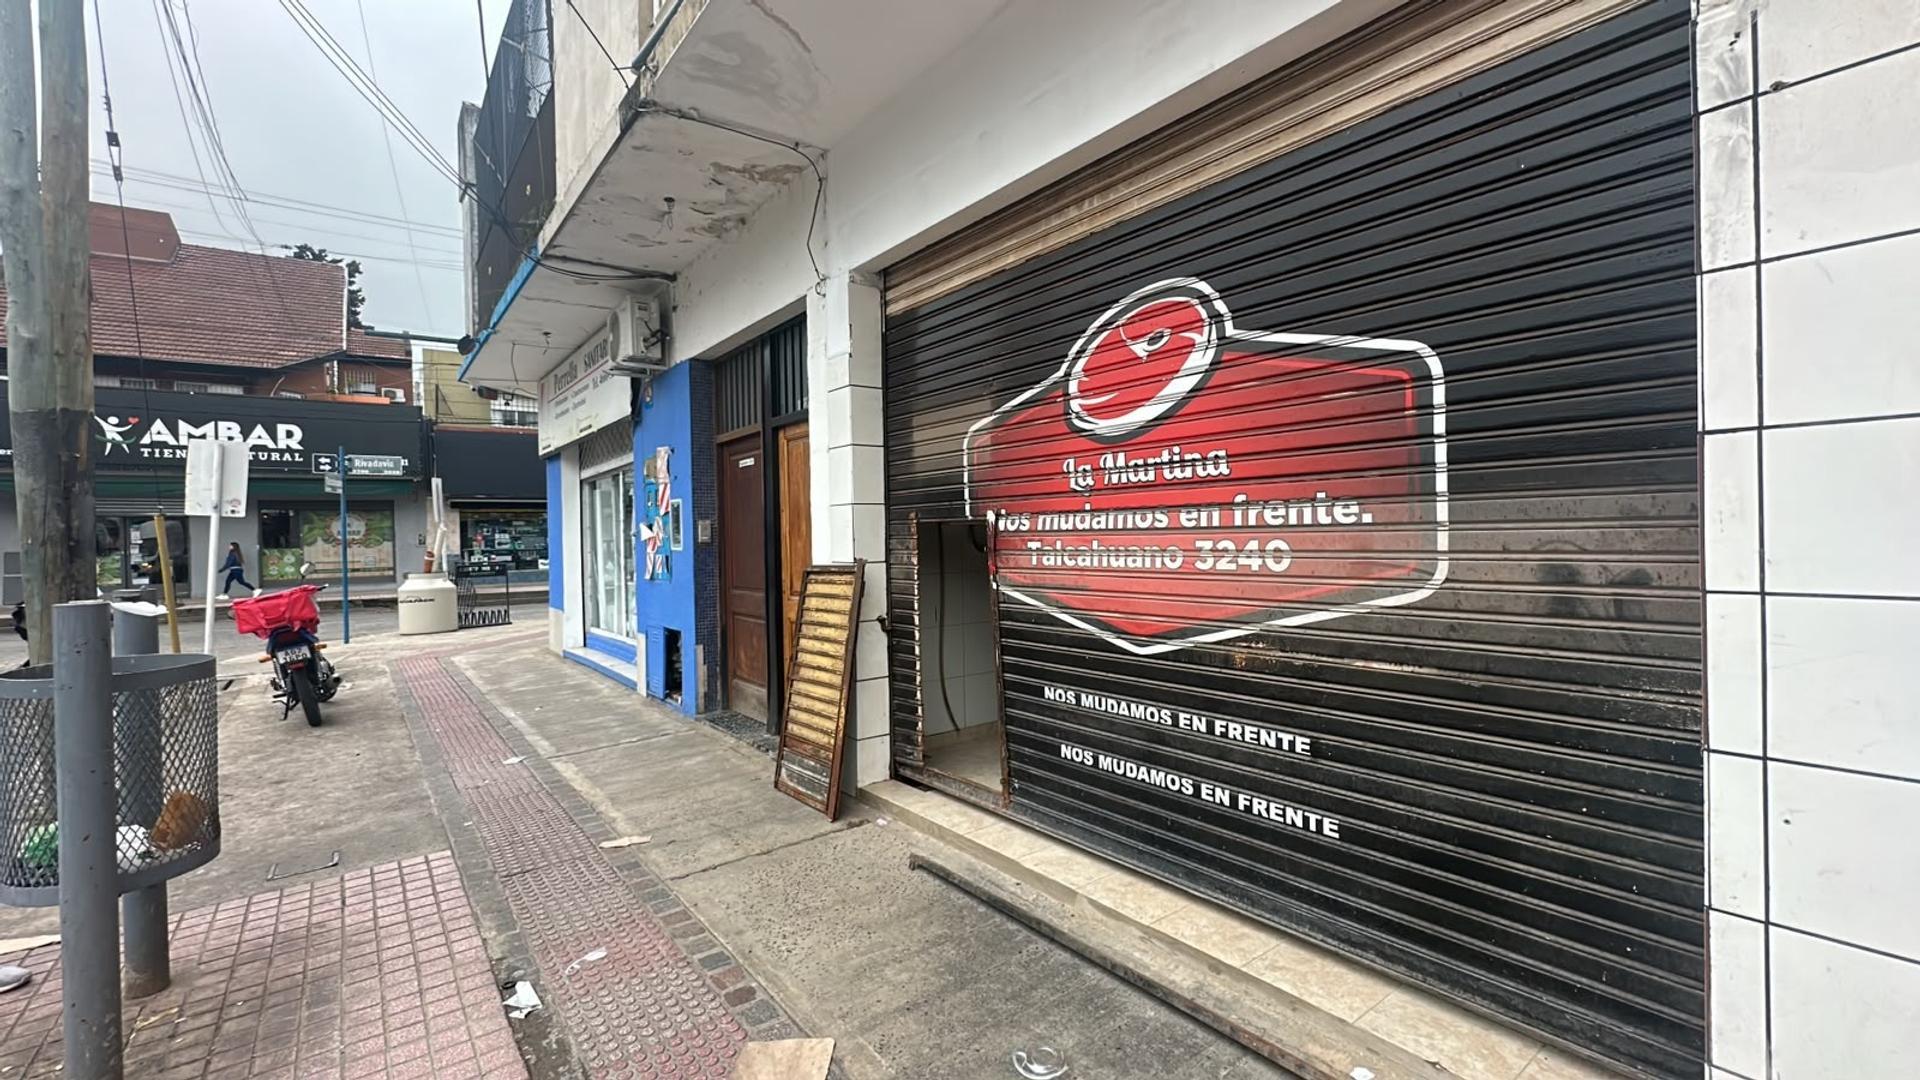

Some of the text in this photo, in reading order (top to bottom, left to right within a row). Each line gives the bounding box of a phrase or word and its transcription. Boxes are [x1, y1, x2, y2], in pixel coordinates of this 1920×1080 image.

[584, 337, 608, 373] SANITAR
[139, 418, 304, 450] AMBAR
[140, 447, 304, 462] TIEN TURAL
[354, 458, 395, 469] Rivadavia
[1063, 446, 1231, 496] La Martina
[1036, 503, 1170, 532] mudamos
[1179, 506, 1220, 528] en
[1233, 491, 1374, 527] frente.
[1026, 538, 1293, 573] Talcahuano 3240
[1044, 686, 1312, 756] NOS MUDAMOS EN FRENTE
[1060, 744, 1340, 839] NOS MUDAMOS EN FRENTE
